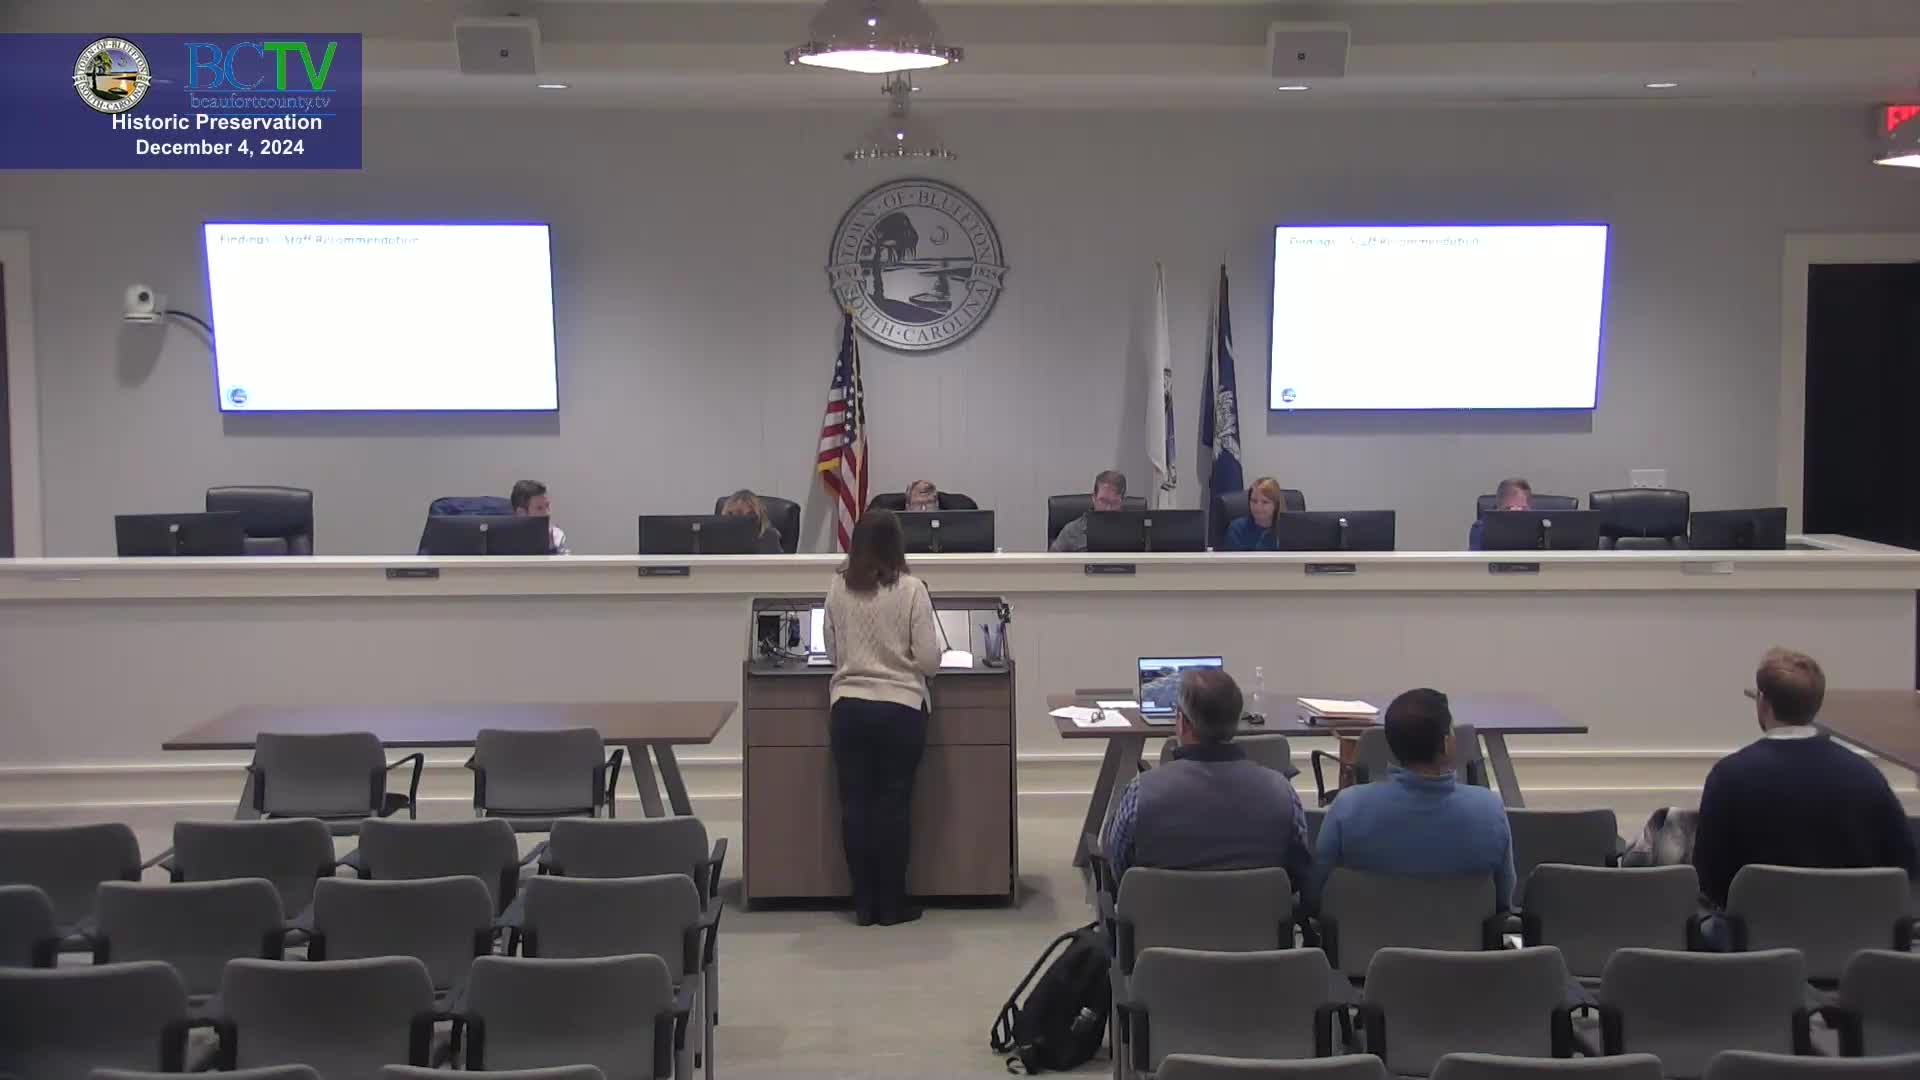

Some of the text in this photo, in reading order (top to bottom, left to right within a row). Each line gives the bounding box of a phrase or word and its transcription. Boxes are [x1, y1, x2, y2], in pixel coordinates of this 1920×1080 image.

[841, 190, 993, 261] TOWN OF BLUFFTON
[903, 286, 988, 343] CAROLINA
